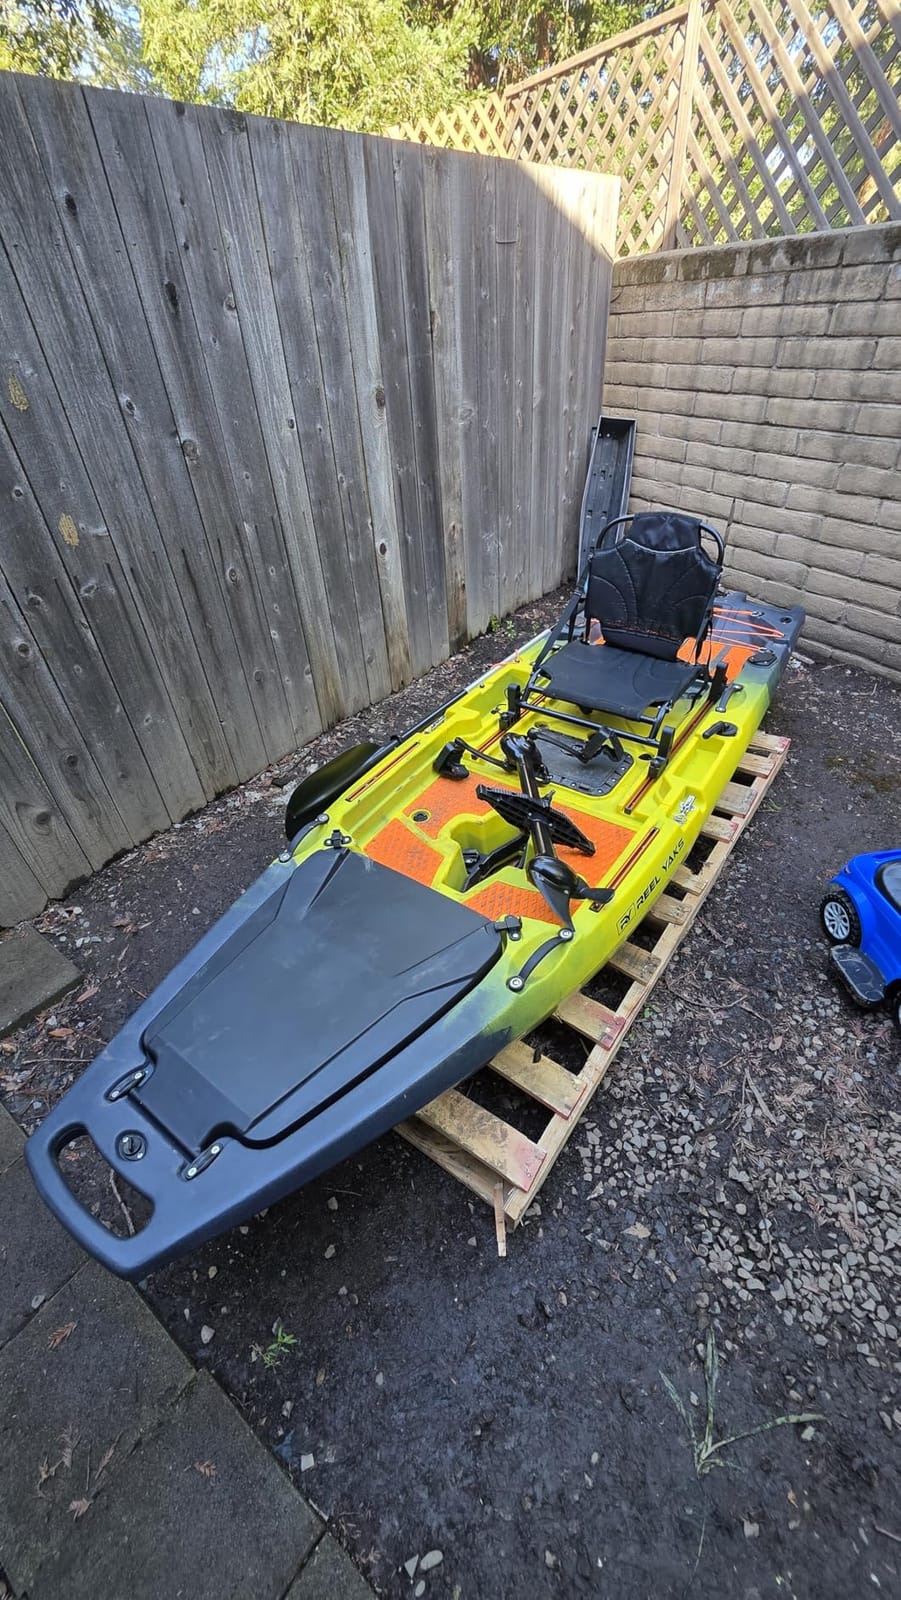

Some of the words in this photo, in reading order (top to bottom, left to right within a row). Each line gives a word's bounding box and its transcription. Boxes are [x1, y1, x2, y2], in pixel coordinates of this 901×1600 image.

[619, 910, 633, 930] RY
[636, 876, 661, 909] REEL
[662, 838, 684, 872] YAKS
